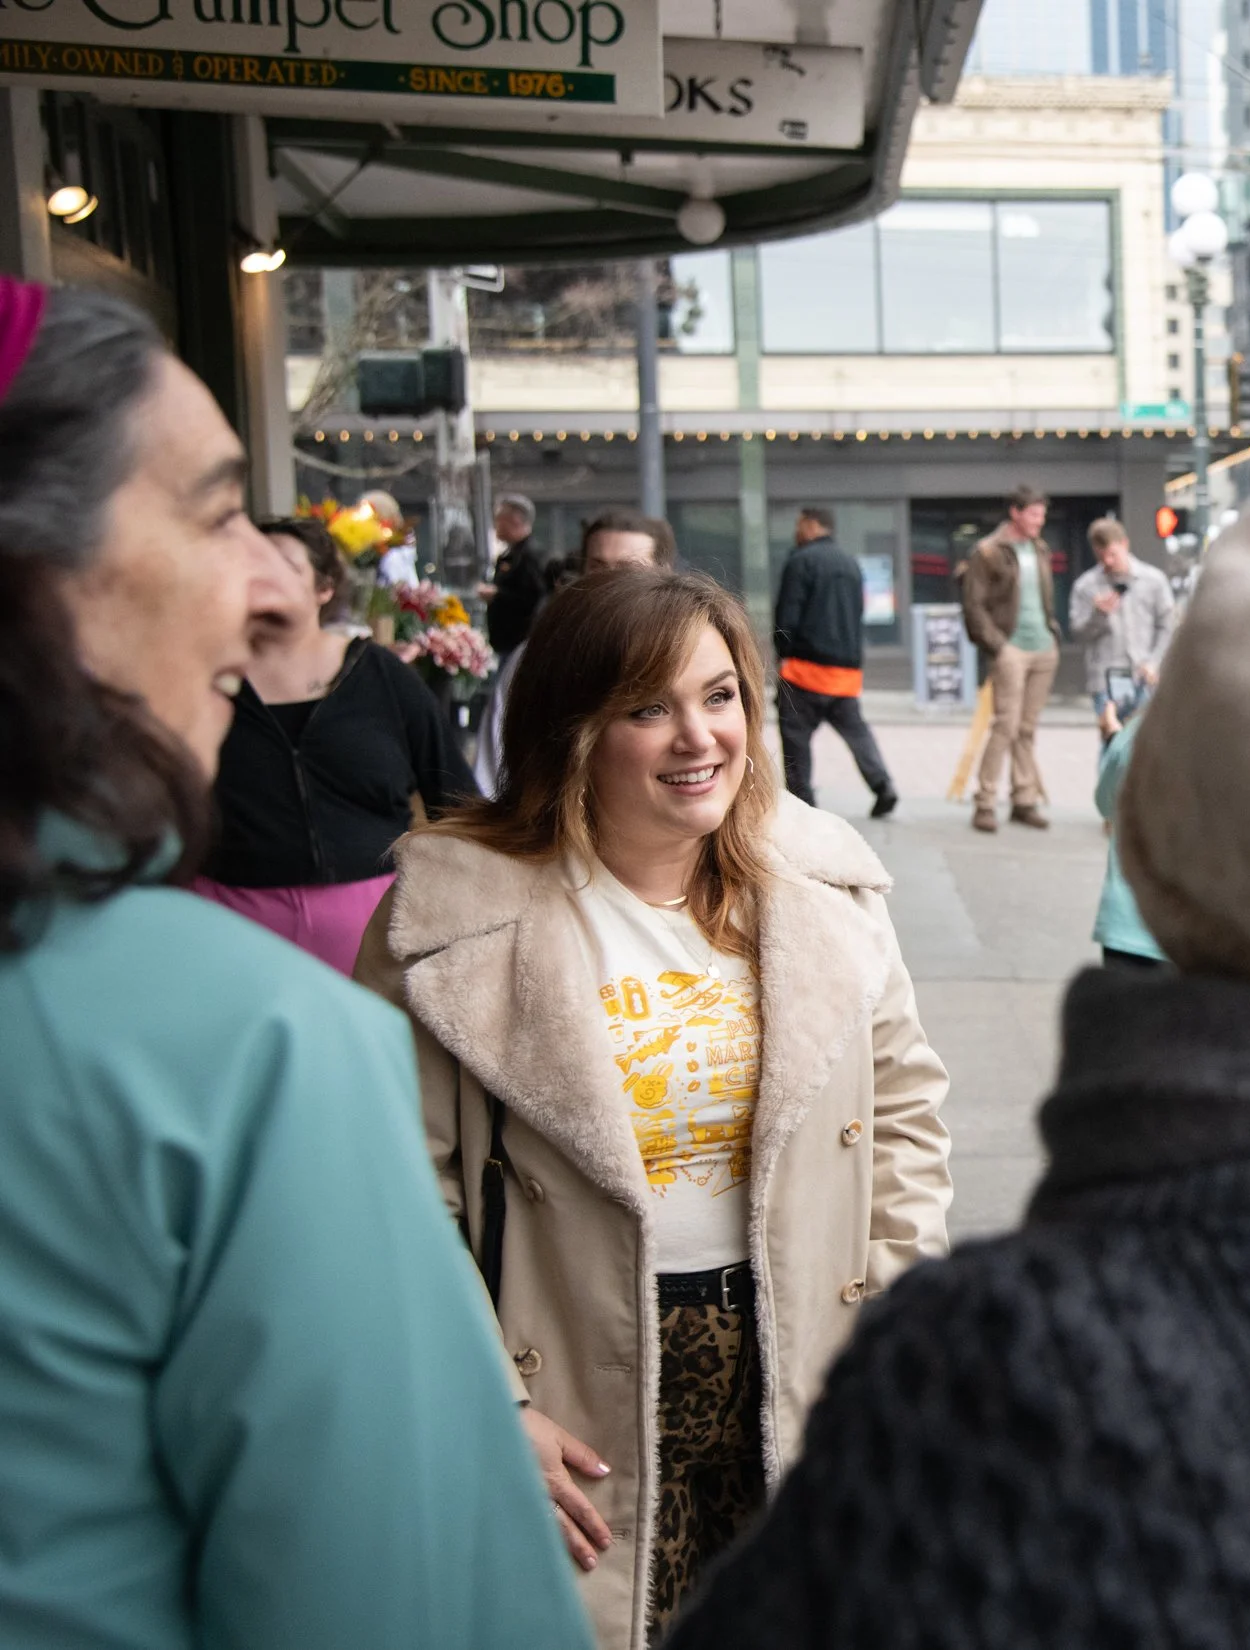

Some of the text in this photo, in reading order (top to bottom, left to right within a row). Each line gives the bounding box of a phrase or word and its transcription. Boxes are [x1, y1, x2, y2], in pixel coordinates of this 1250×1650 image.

[62, 47, 164, 75] OWNED
[194, 55, 338, 87] OPERATED
[409, 67, 488, 94] SINCE
[507, 71, 566, 98] 1976
[727, 1014, 763, 1039] PU
